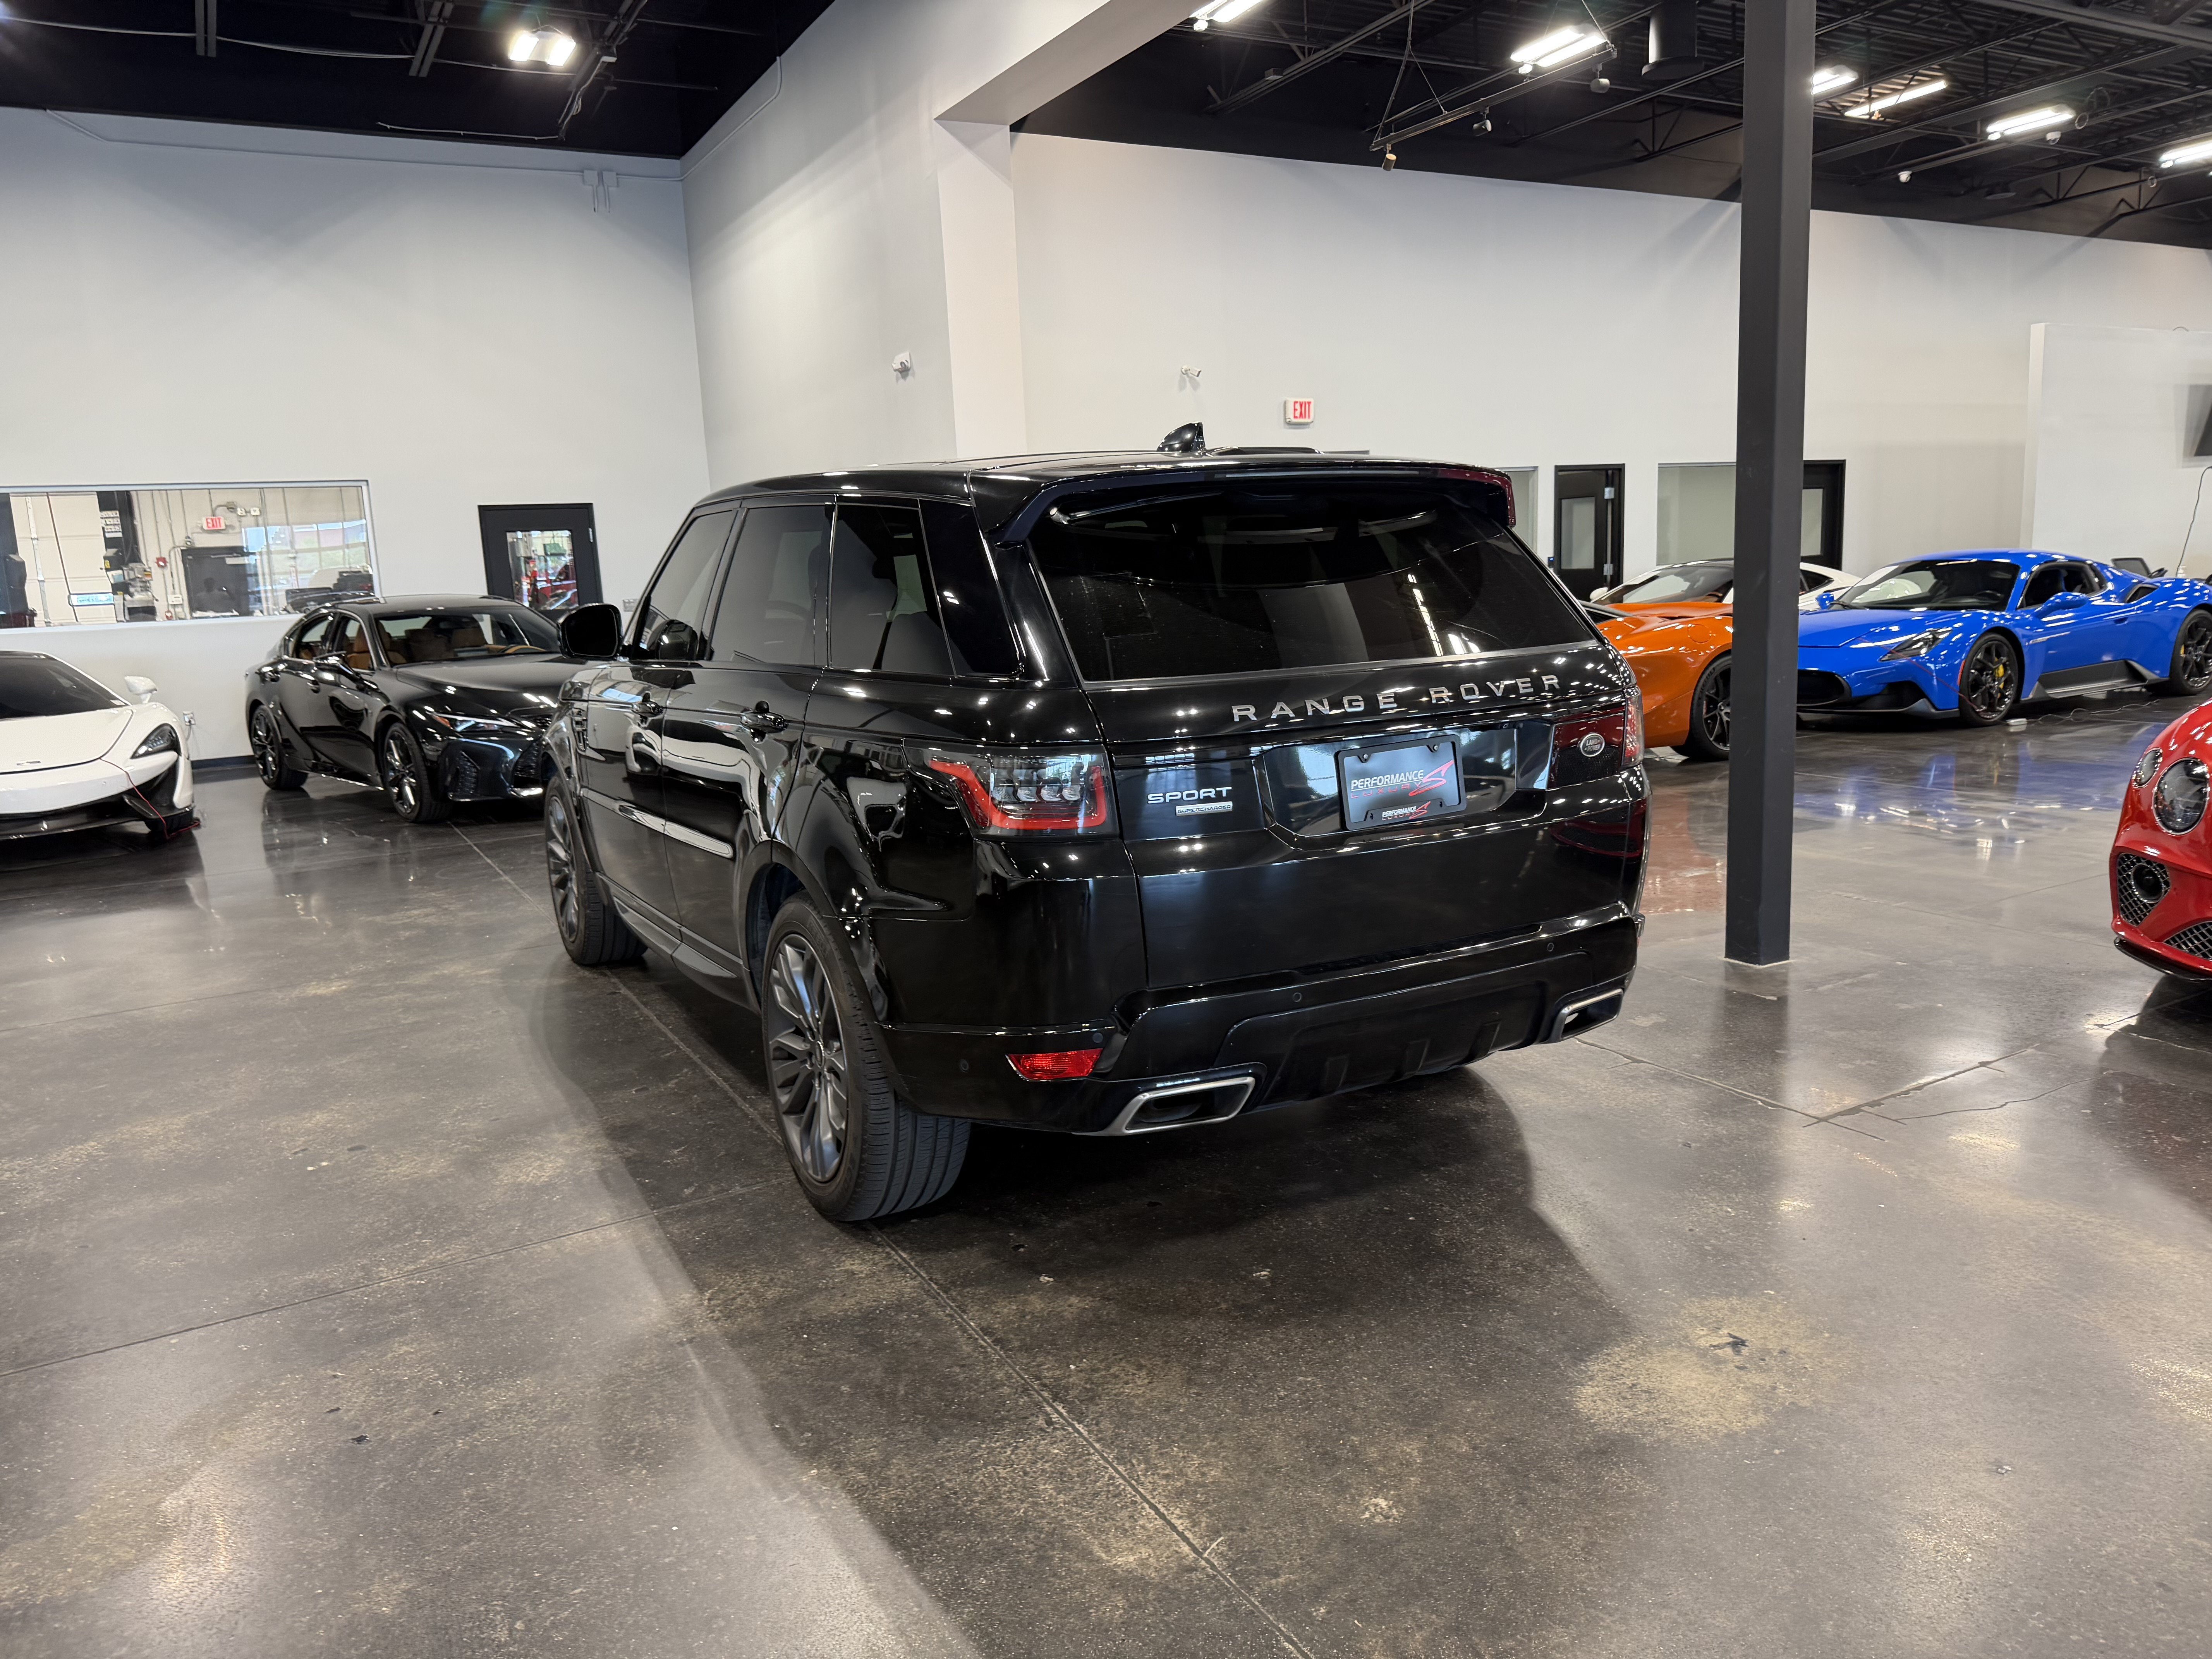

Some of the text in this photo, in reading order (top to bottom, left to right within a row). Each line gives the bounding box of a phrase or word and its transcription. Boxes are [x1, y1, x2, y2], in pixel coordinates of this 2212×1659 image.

[1293, 401, 1311, 419] EXIT
[206, 517, 221, 528] EXIT
[1232, 675, 1561, 721] RANGE ROVER
[1351, 769, 1424, 790] PERFORMANCE
[1147, 787, 1232, 804] SPORT
[1350, 781, 1422, 799] LUXURY
[1178, 804, 1231, 813] SUPERCHARGED
[1382, 806, 1417, 816] PERFORMANCE
